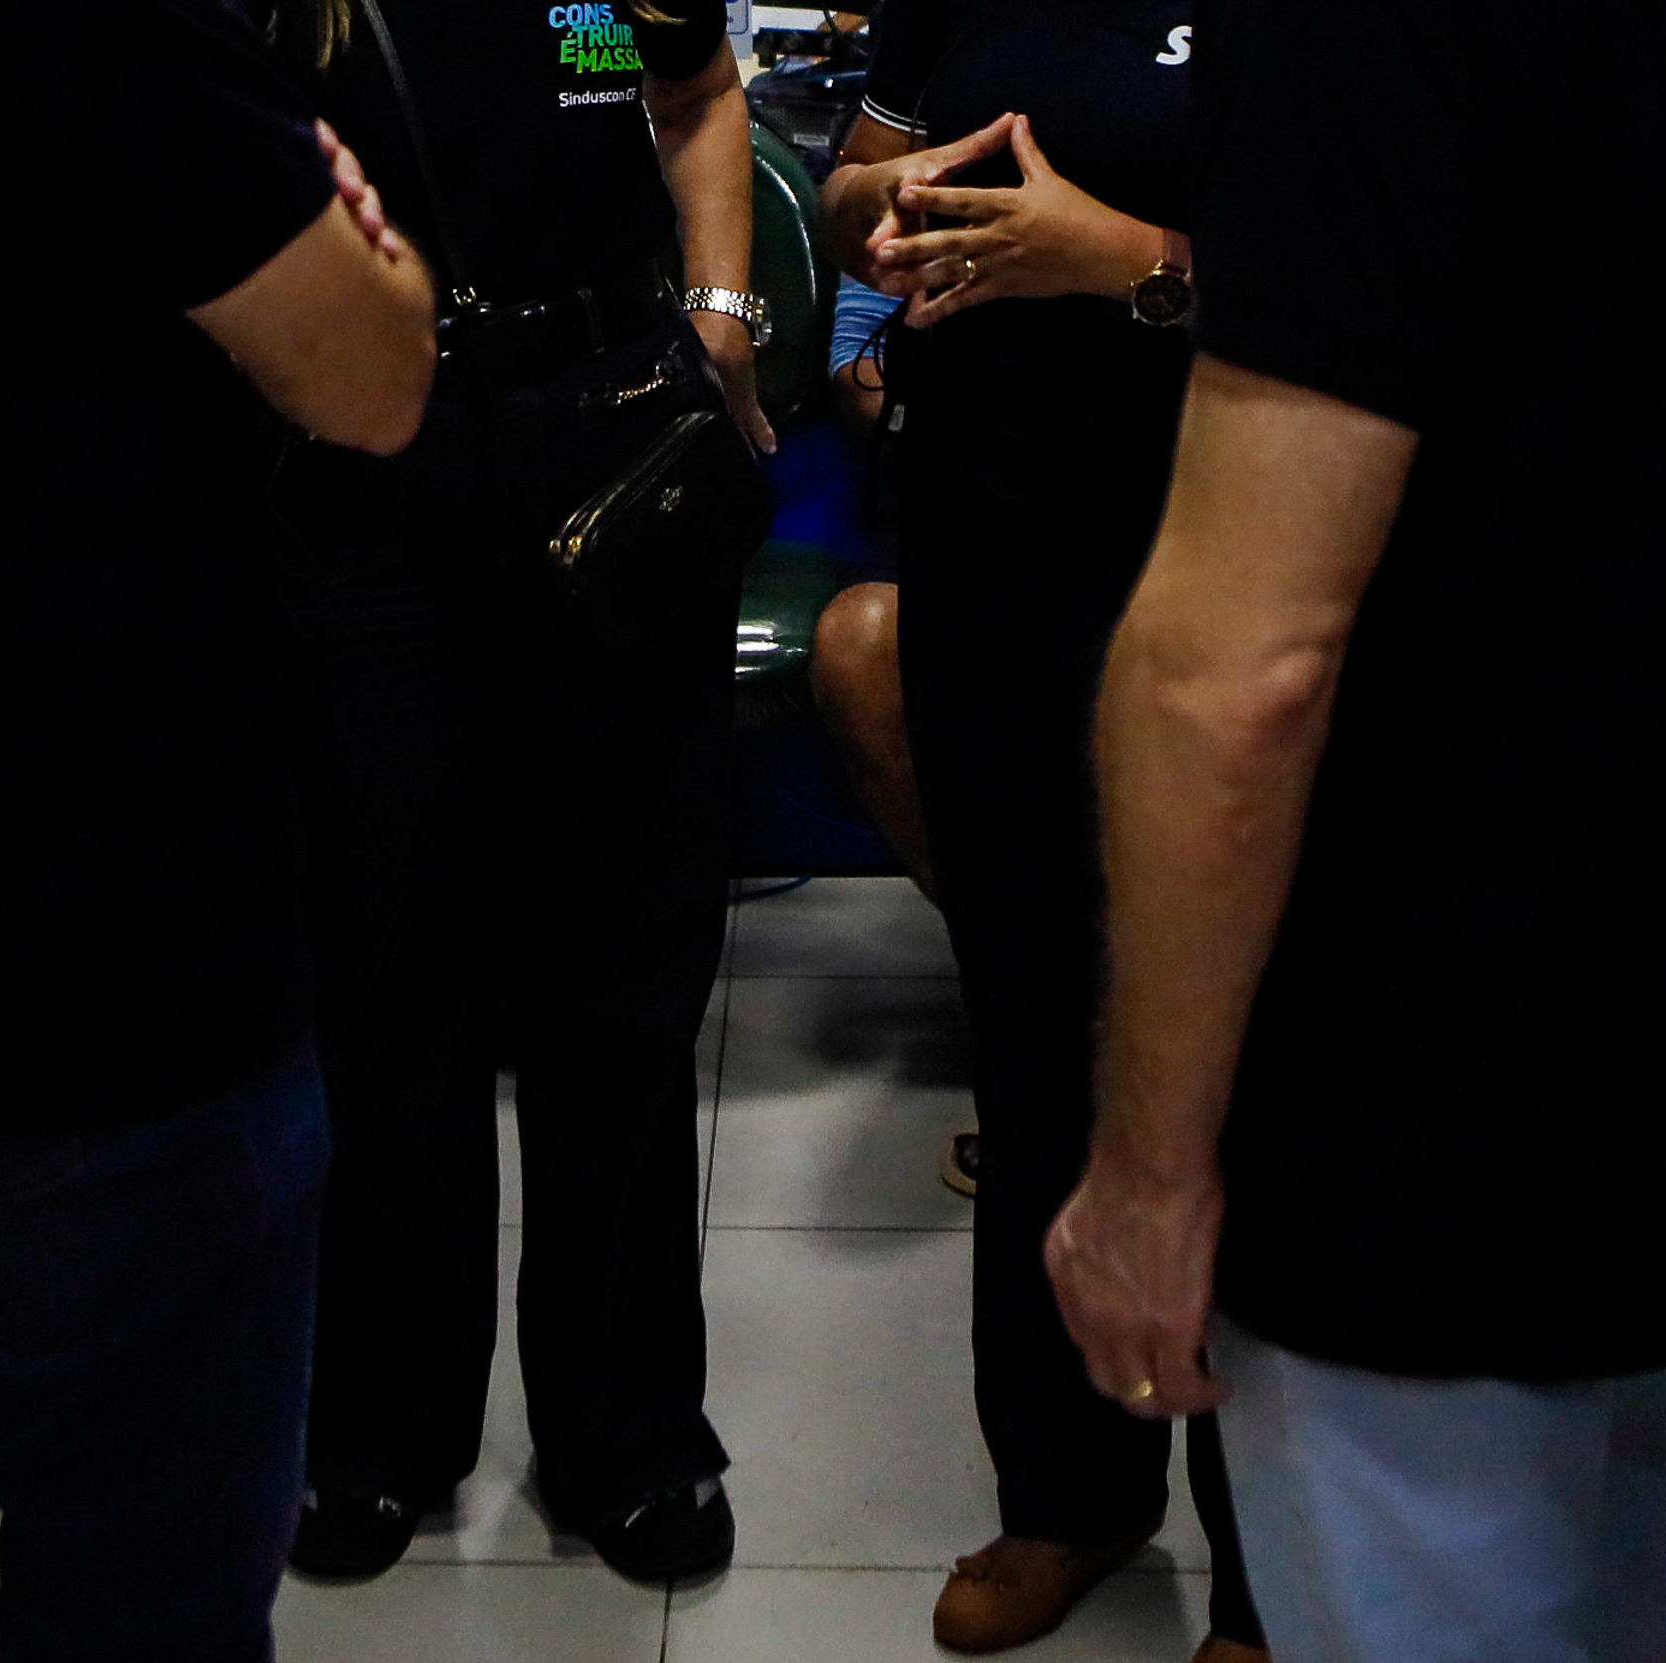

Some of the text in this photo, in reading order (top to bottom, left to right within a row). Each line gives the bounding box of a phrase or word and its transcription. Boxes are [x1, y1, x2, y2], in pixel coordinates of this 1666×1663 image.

[548, 2, 615, 29] CONS
[572, 23, 634, 49] TRUIR
[576, 46, 644, 74] MASSA
